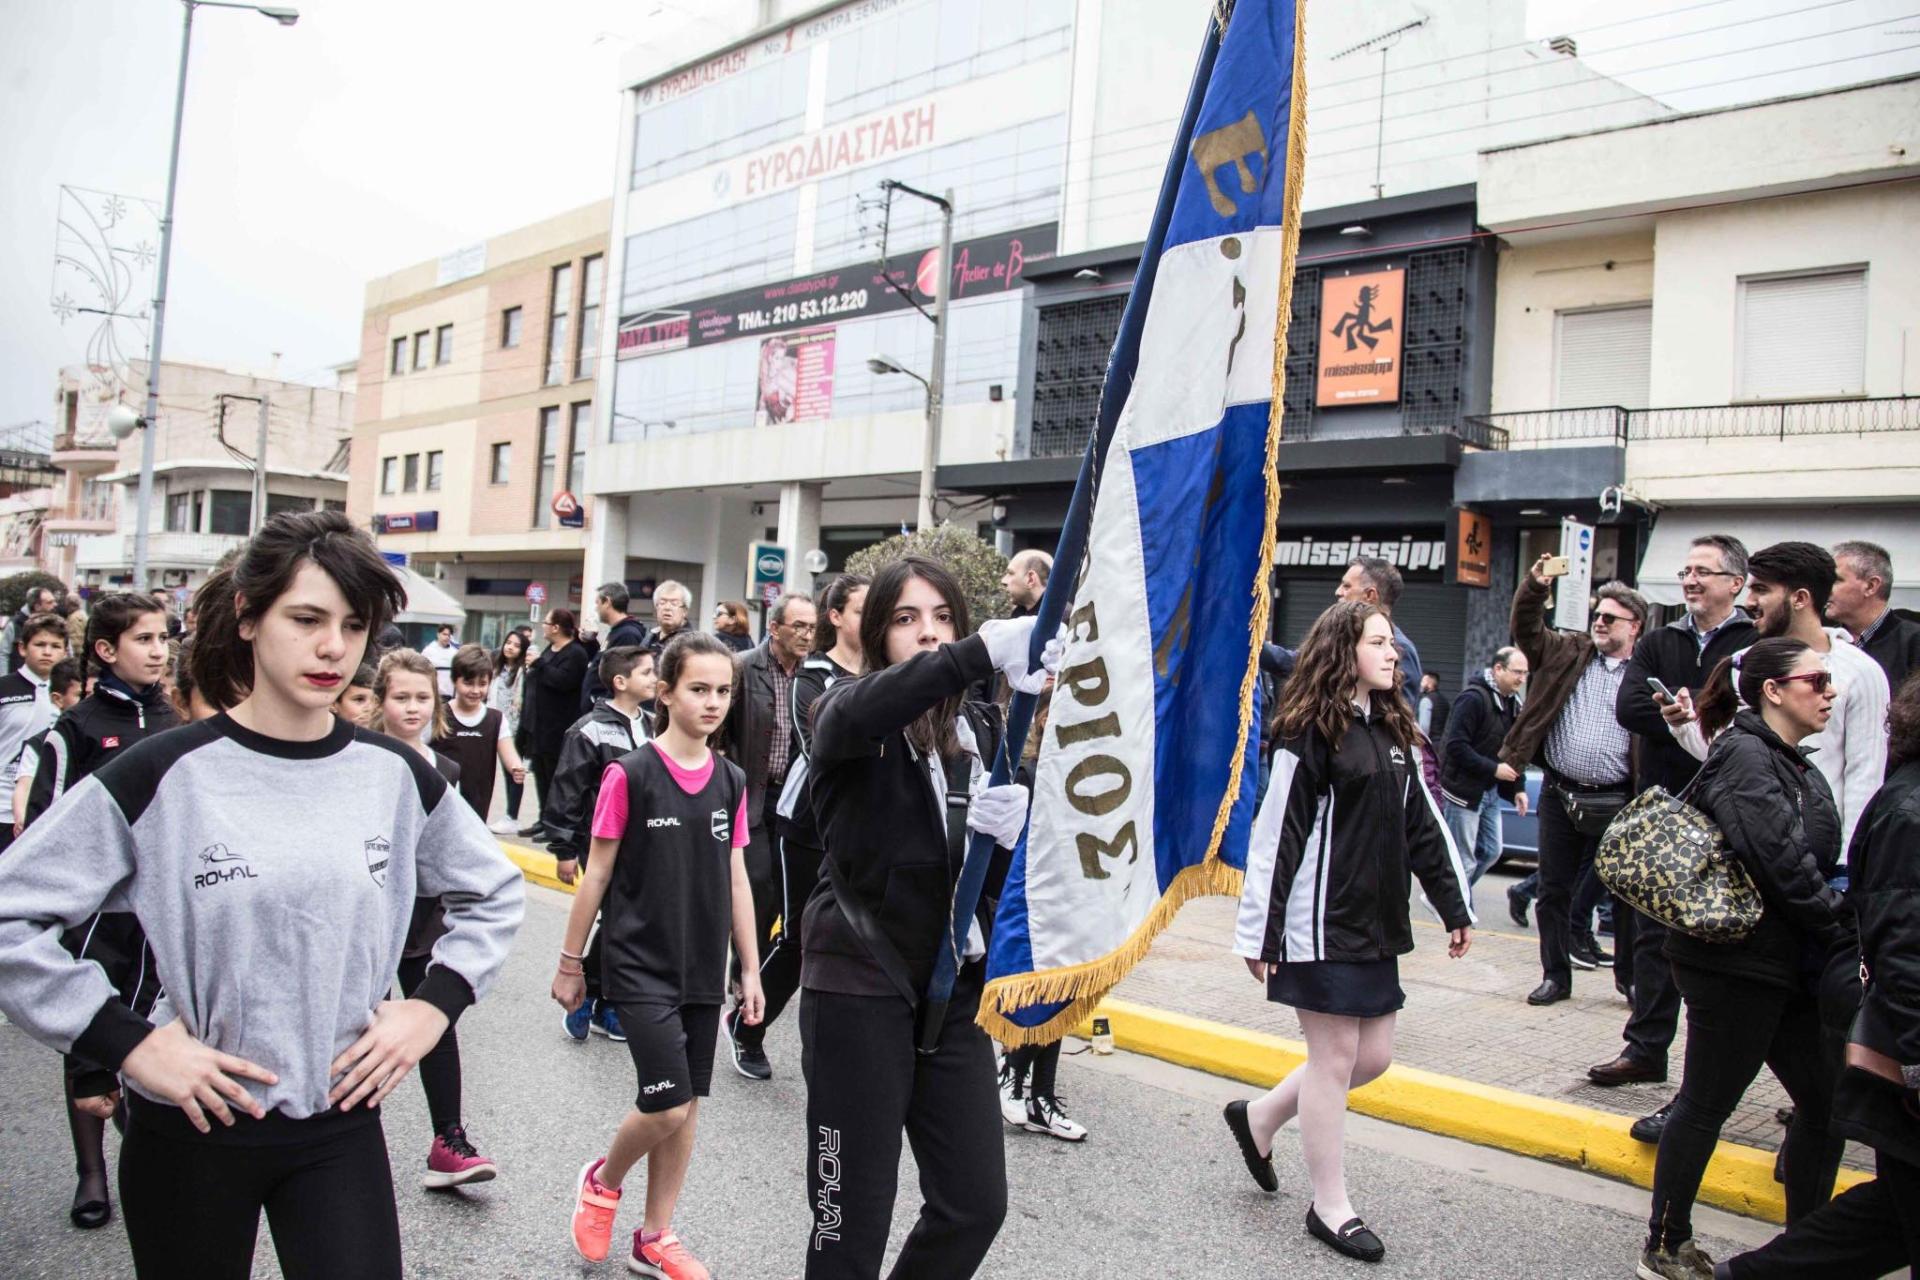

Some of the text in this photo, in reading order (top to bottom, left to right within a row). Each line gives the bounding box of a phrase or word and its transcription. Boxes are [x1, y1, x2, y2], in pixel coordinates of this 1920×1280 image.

[746, 102, 935, 195] ΕΥΡΩΔΙΑΣΤΑΣΗ
[737, 310, 771, 331] ΤΗΛ.:
[773, 303, 798, 324] 210
[799, 288, 868, 320] 53.12.220
[618, 327, 650, 351] DATA
[656, 319, 689, 343] TYPE
[1273, 535, 1446, 570] mississipp
[1056, 551, 1138, 880] ΕΡΙΟΣ
[646, 817, 681, 829] ROYAL
[194, 864, 258, 890] ROYAL
[643, 1080, 676, 1096] ROYAL
[815, 1125, 842, 1251] ROYAL
